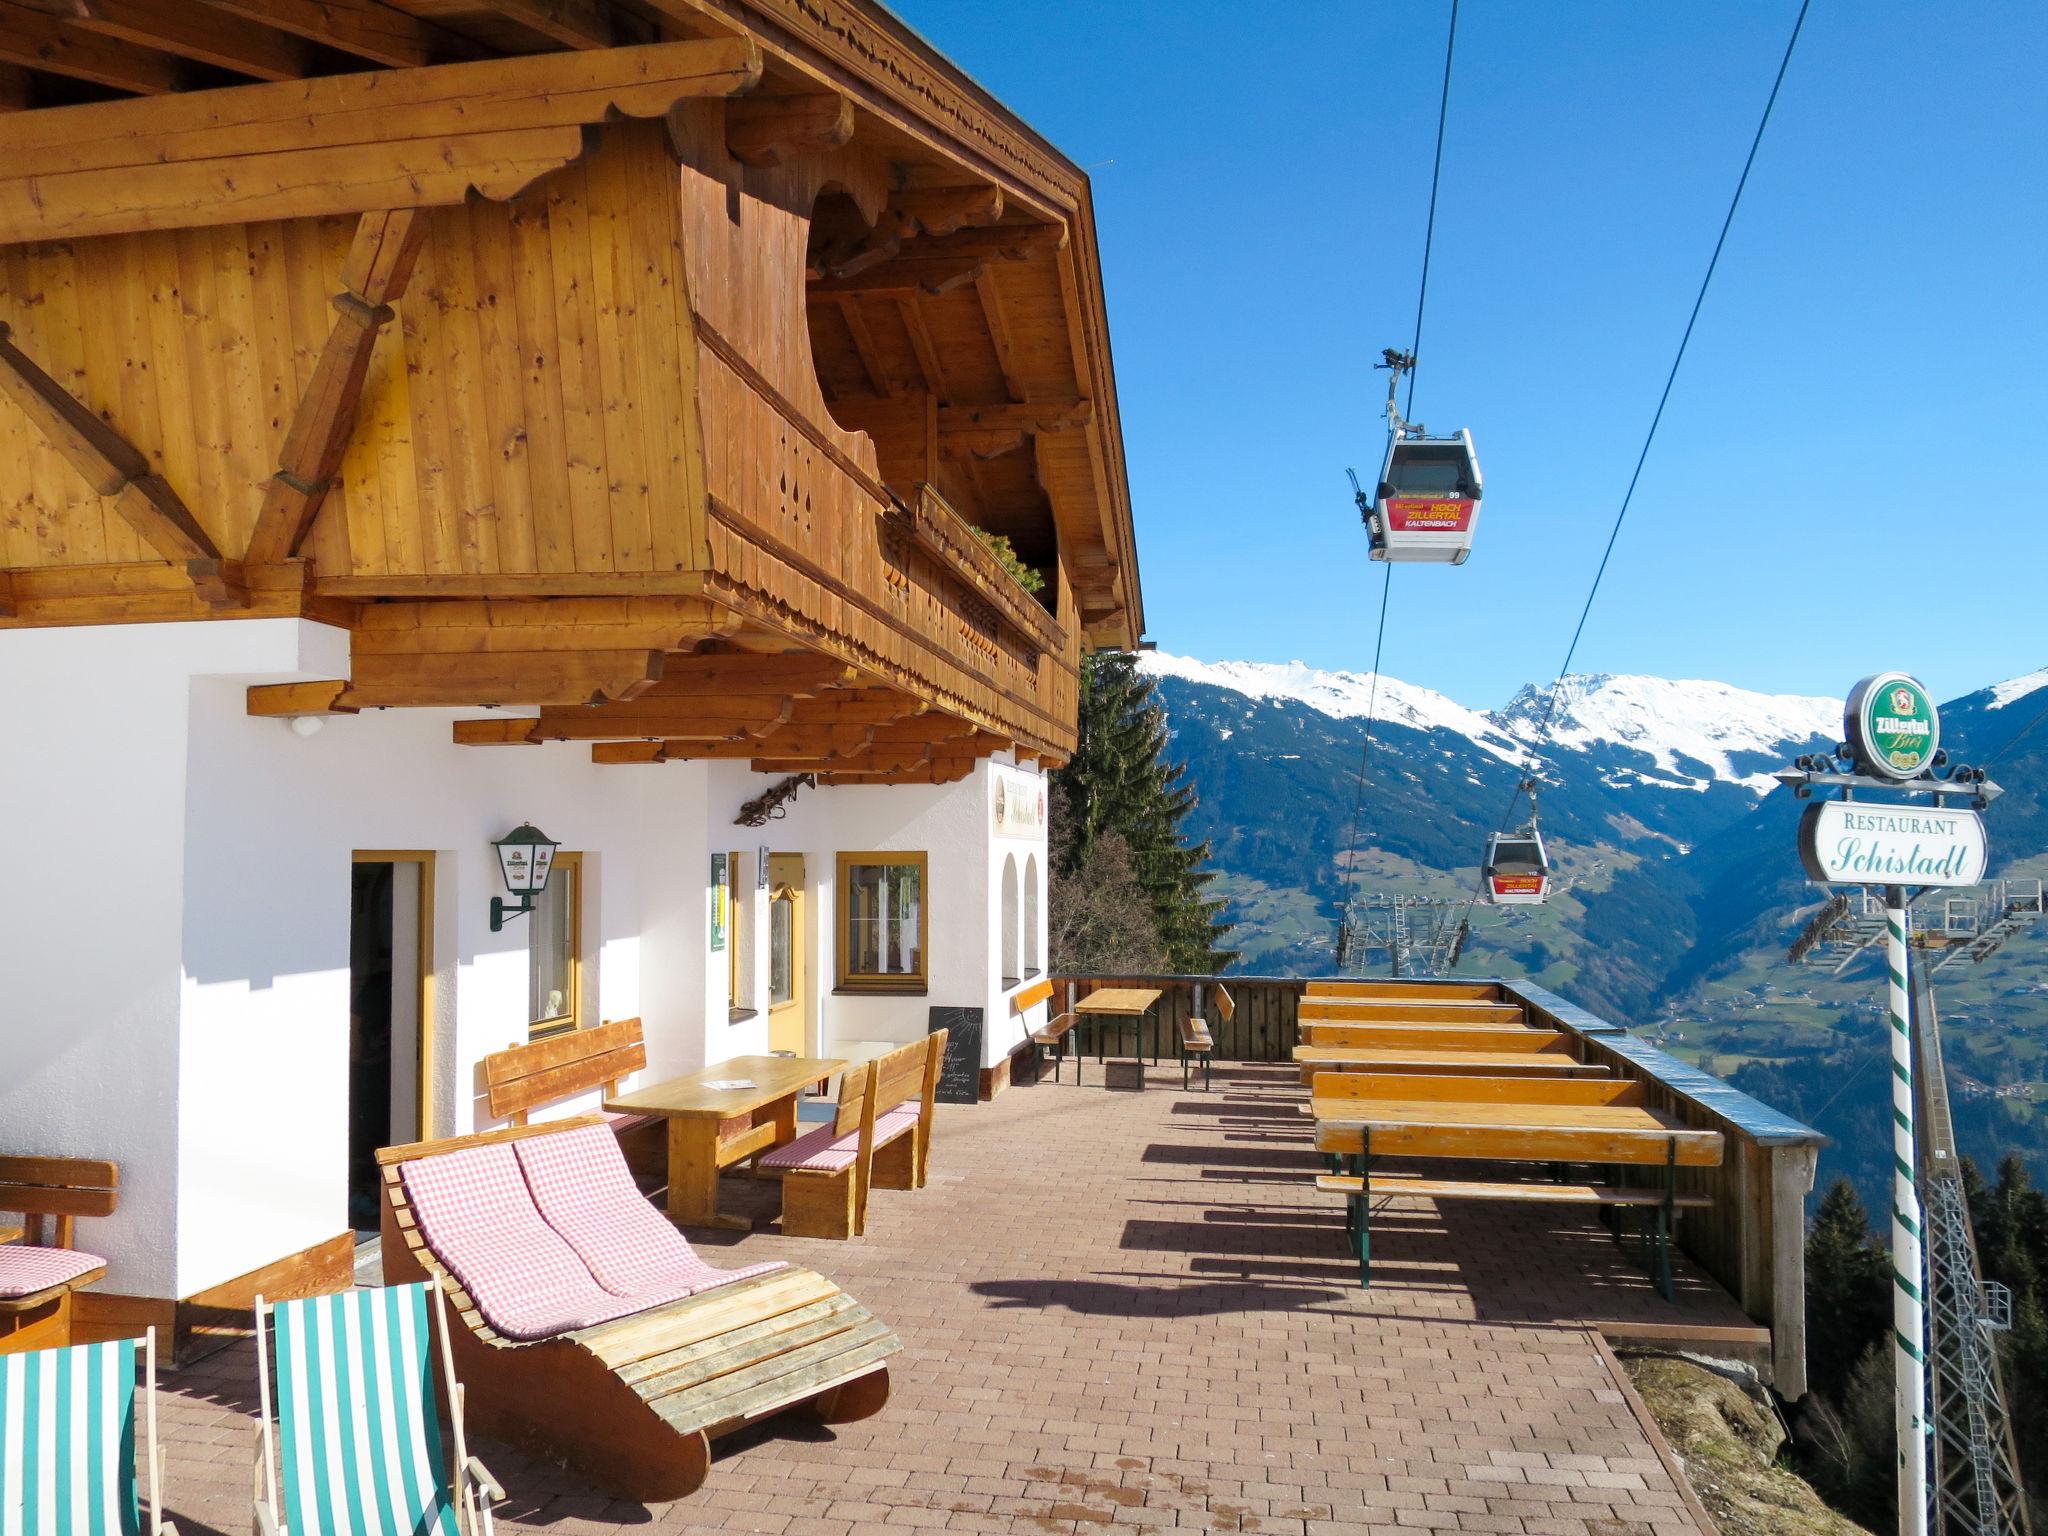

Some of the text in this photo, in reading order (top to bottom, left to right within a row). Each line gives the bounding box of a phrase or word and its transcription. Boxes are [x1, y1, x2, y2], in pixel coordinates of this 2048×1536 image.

[1431, 503, 1462, 512] HOCH
[1407, 511, 1462, 520] ZILLERTAL
[1405, 520, 1457, 528] KALTENBACH
[1876, 717, 1930, 735] Zillertal
[1844, 812, 1958, 836] RESTAURANT
[1830, 836, 1969, 877] Schistadl
